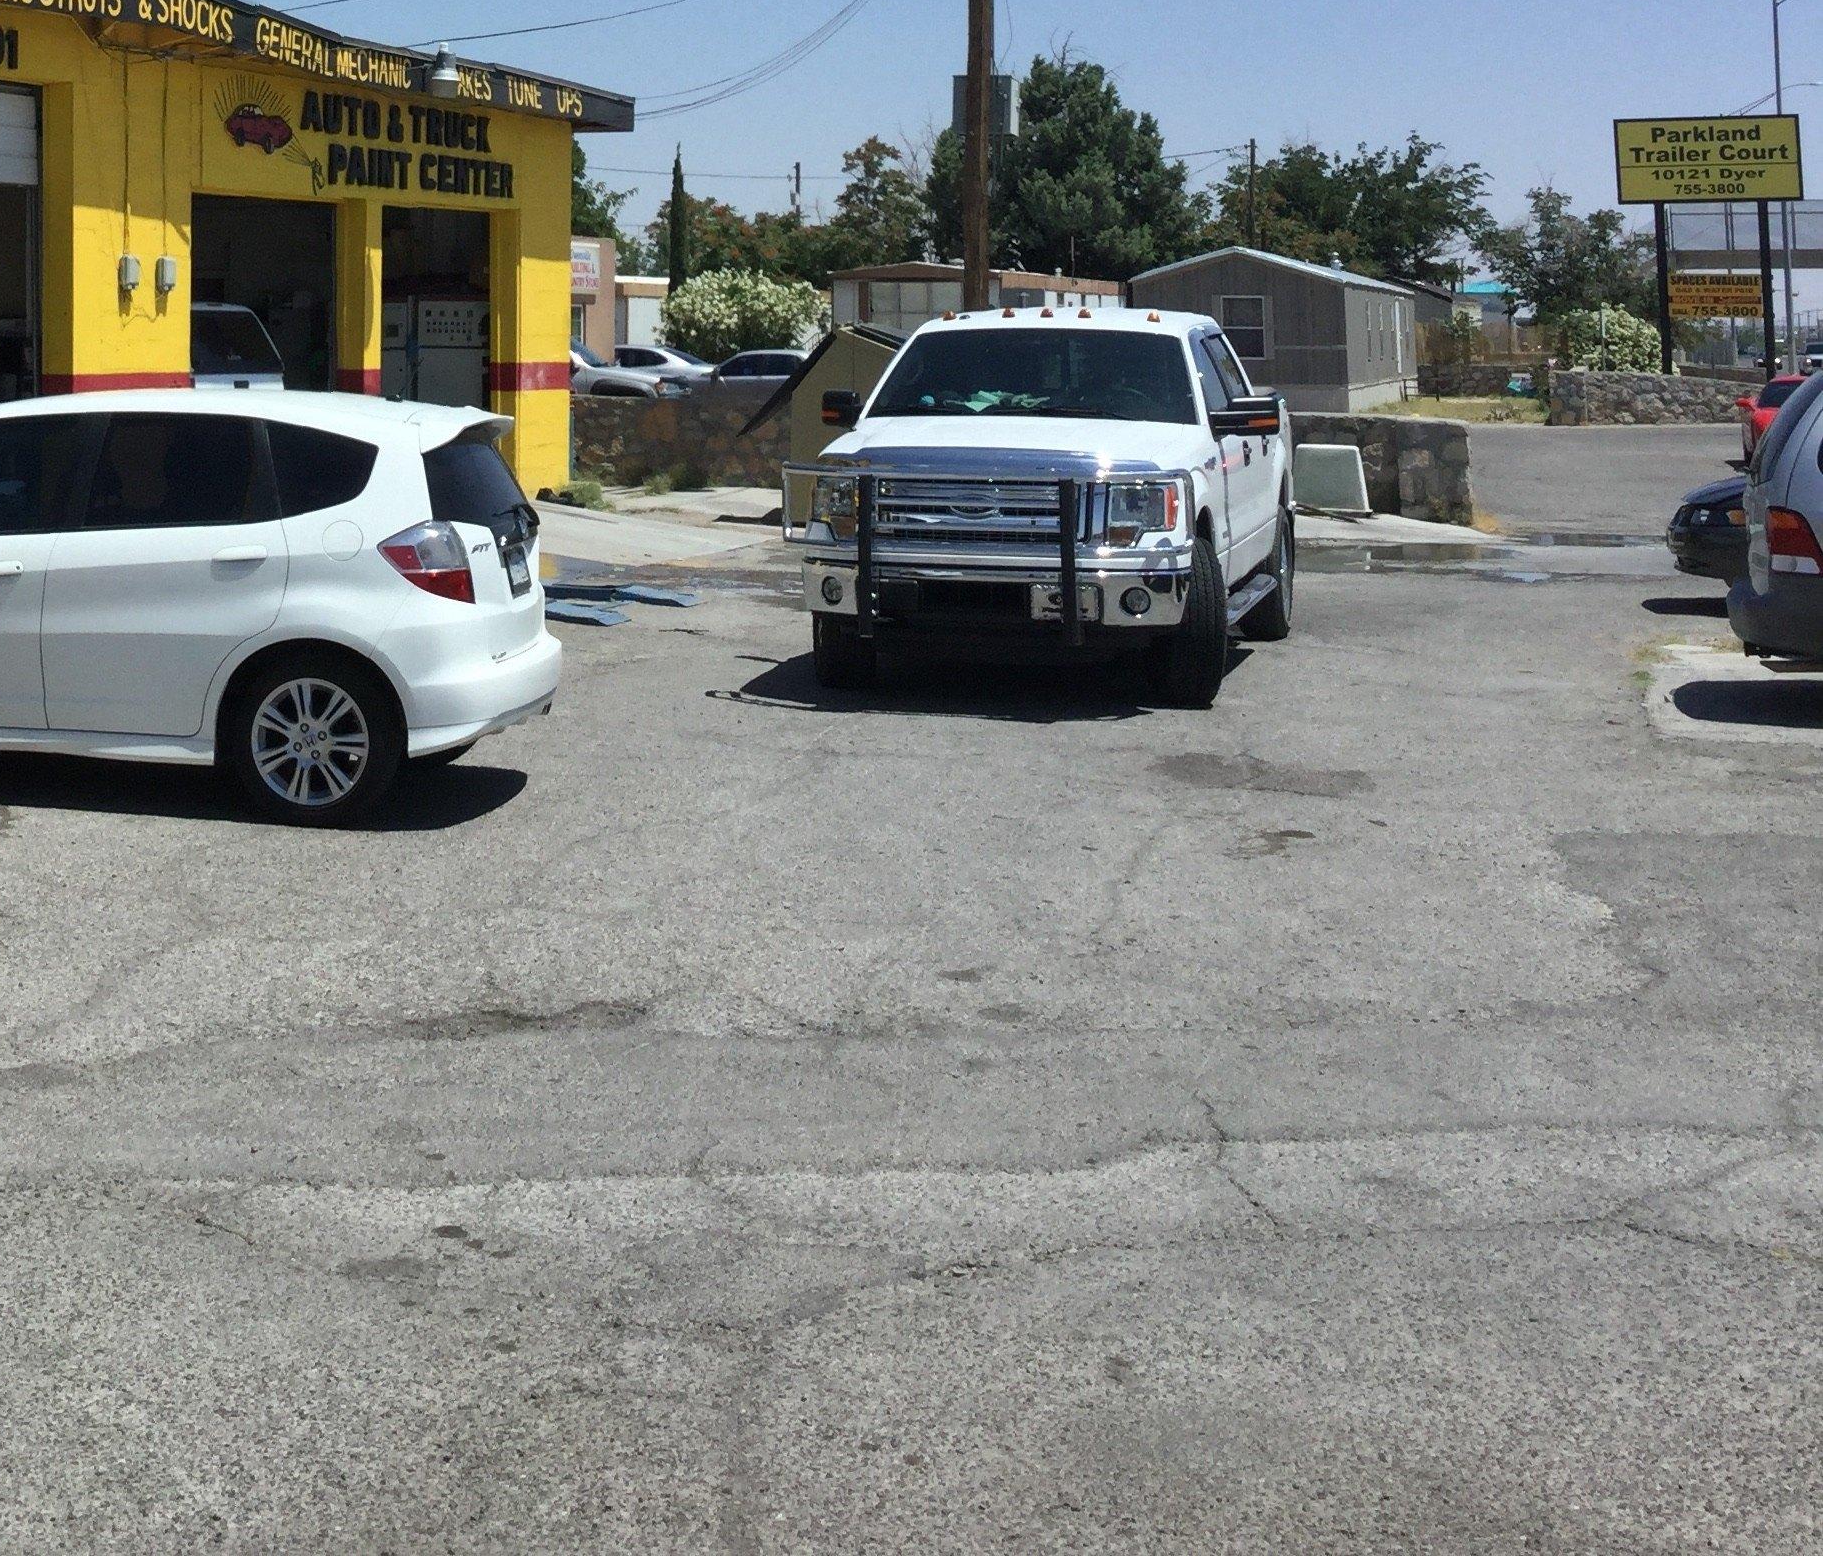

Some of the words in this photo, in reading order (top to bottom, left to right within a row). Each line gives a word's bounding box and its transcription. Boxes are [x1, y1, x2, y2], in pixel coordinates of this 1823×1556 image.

[256, 17, 334, 77] GENERAL
[507, 75, 543, 109] TUNE
[556, 89, 583, 117] UPS
[300, 90, 381, 140] AUTO
[387, 104, 403, 143] &
[408, 105, 491, 153] TRUCK
[1651, 124, 1761, 144] Parkland
[1629, 145, 1711, 163] Trailer
[1719, 143, 1789, 161] Court
[328, 144, 412, 190] PAINT
[419, 153, 514, 198] CENTER
[1651, 168, 1710, 180] 10121
[1719, 168, 1765, 181] Dyer
[1674, 183, 1745, 195] 755-3800
[1691, 306, 1759, 317] 755-3800
